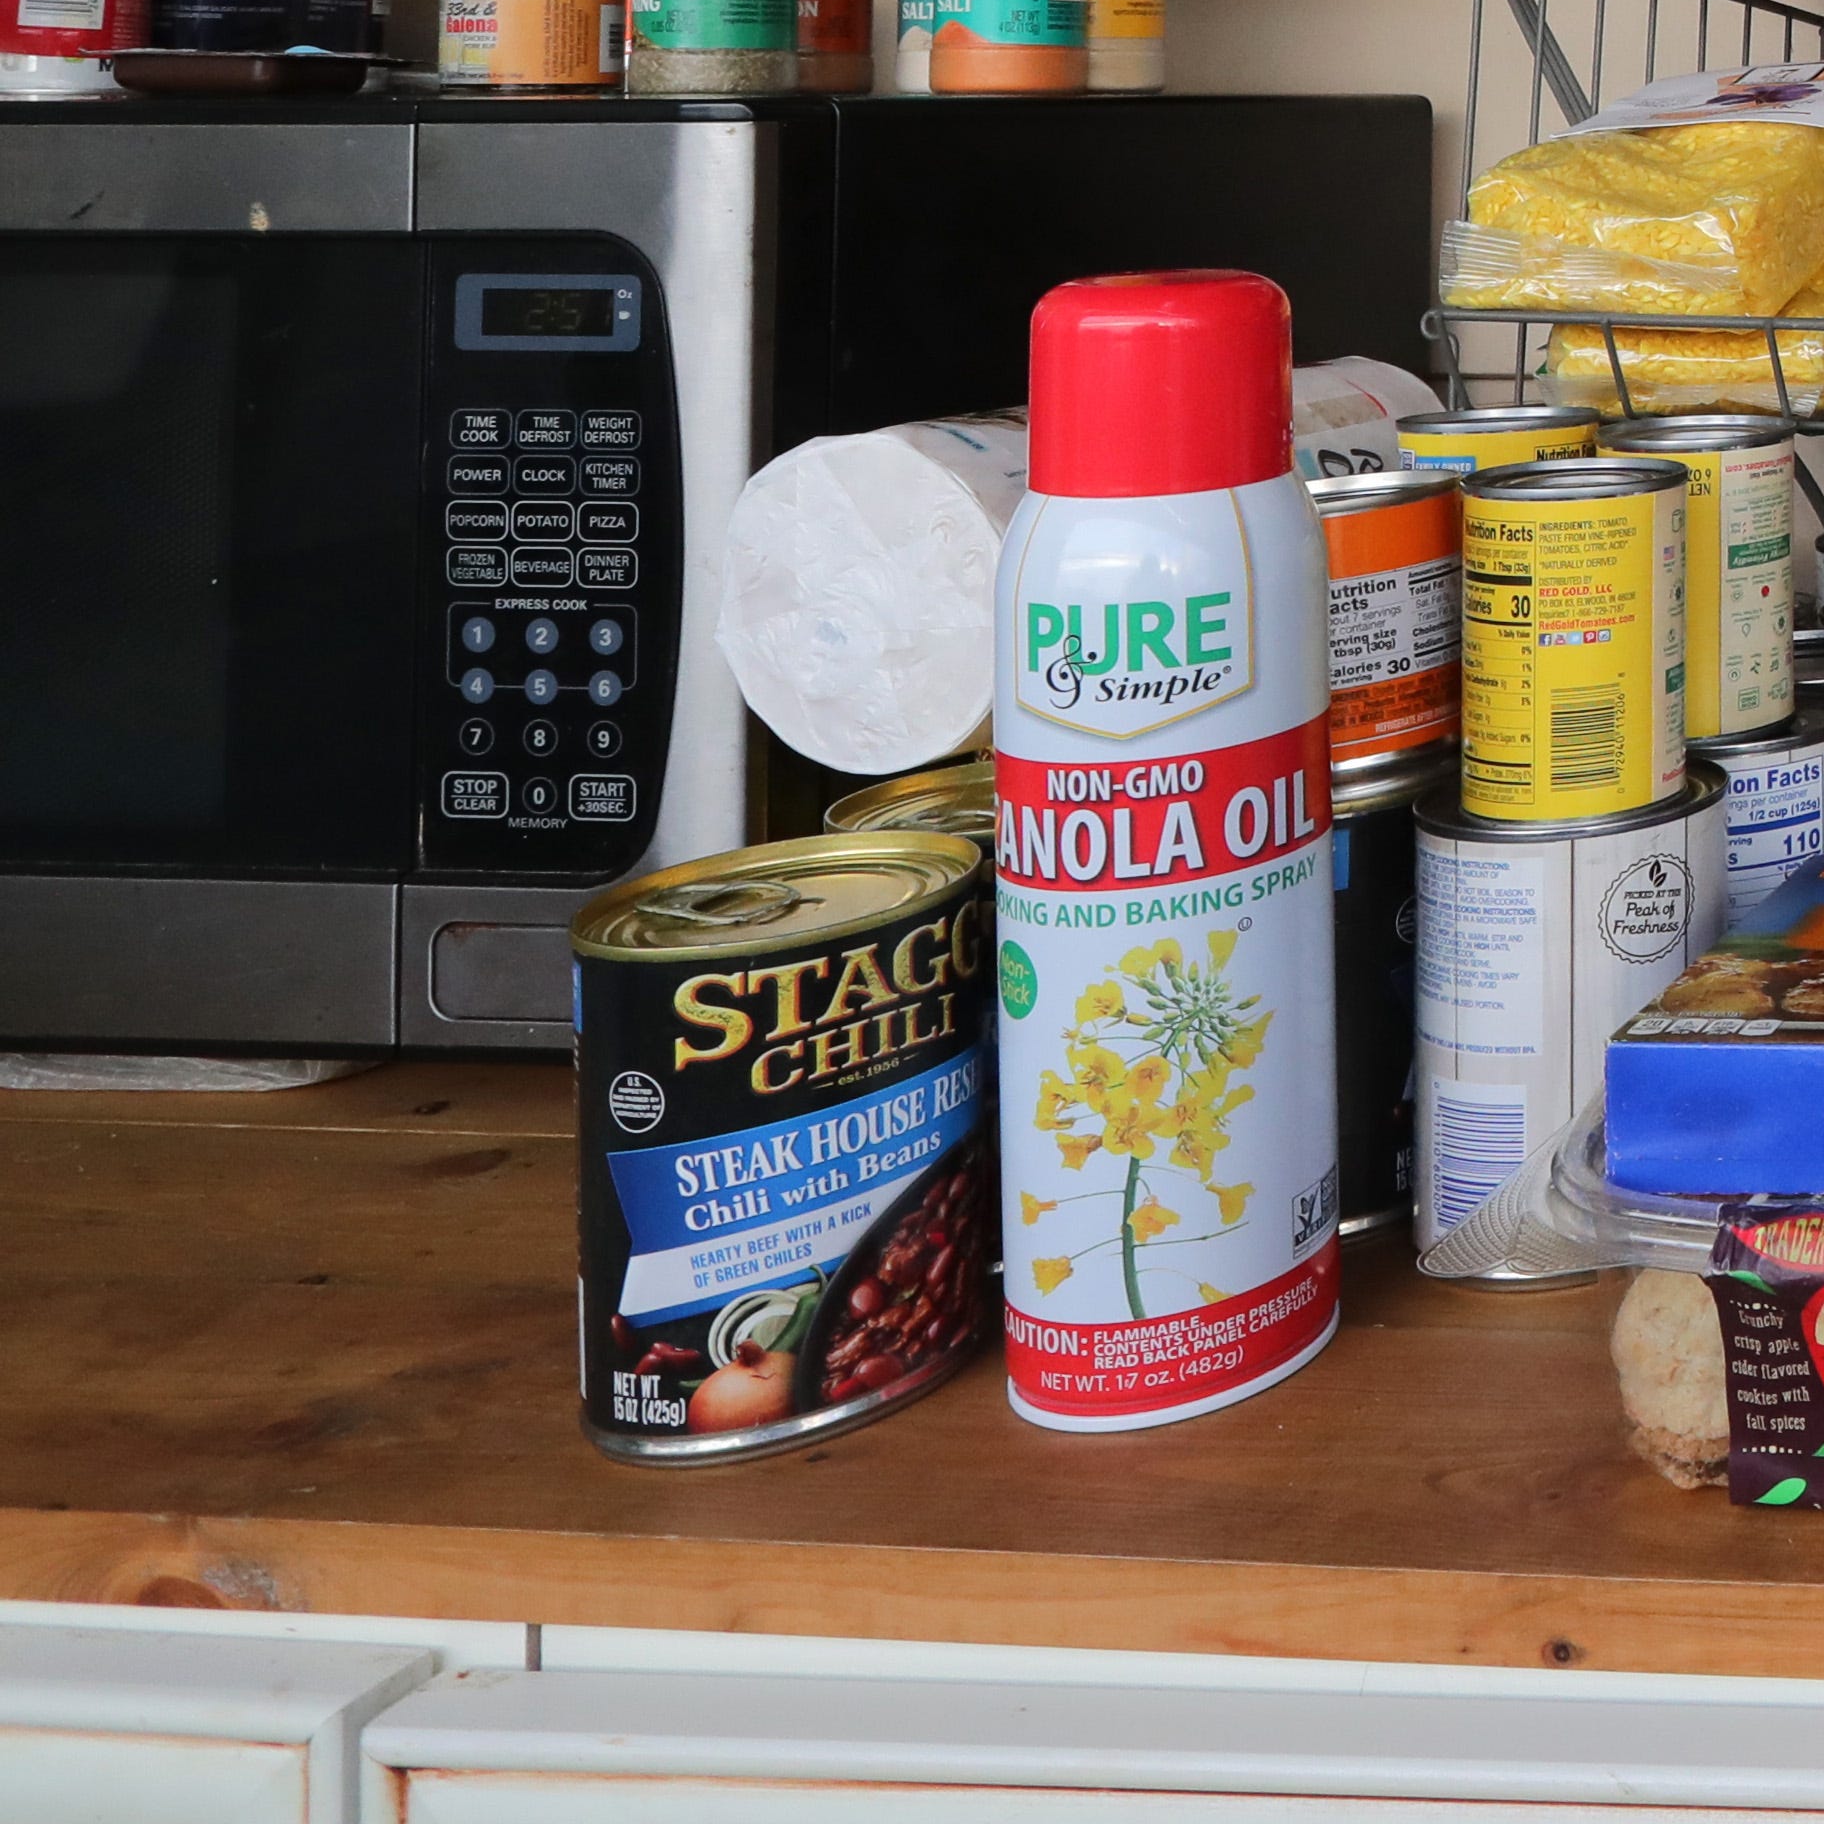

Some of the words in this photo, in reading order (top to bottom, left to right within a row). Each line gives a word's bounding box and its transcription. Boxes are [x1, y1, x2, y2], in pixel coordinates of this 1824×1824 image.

[466, 416, 496, 428] TIME
[460, 430, 498, 442] COOK
[454, 469, 501, 482] POWER
[522, 469, 565, 482] CLOCK
[450, 514, 504, 528] POPCORN
[518, 515, 568, 528] POTATO
[589, 516, 626, 528] PIZZA
[514, 560, 570, 574] BEVERAGE
[495, 598, 549, 611] EXPRESS
[552, 598, 587, 611] COOK
[1028, 592, 1232, 676] PURE
[1096, 668, 1221, 705] Simple
[454, 780, 497, 795] STOP
[1047, 760, 1204, 802] NON-GMO
[579, 783, 626, 798] START
[1224, 770, 1315, 858] OIL
[751, 994, 955, 1094] CHILI
[675, 1135, 802, 1198] STEAK
[809, 1085, 927, 1165] HOUSE
[684, 1193, 772, 1232] Chili
[783, 1171, 850, 1212] with
[858, 1129, 942, 1185] Beans
